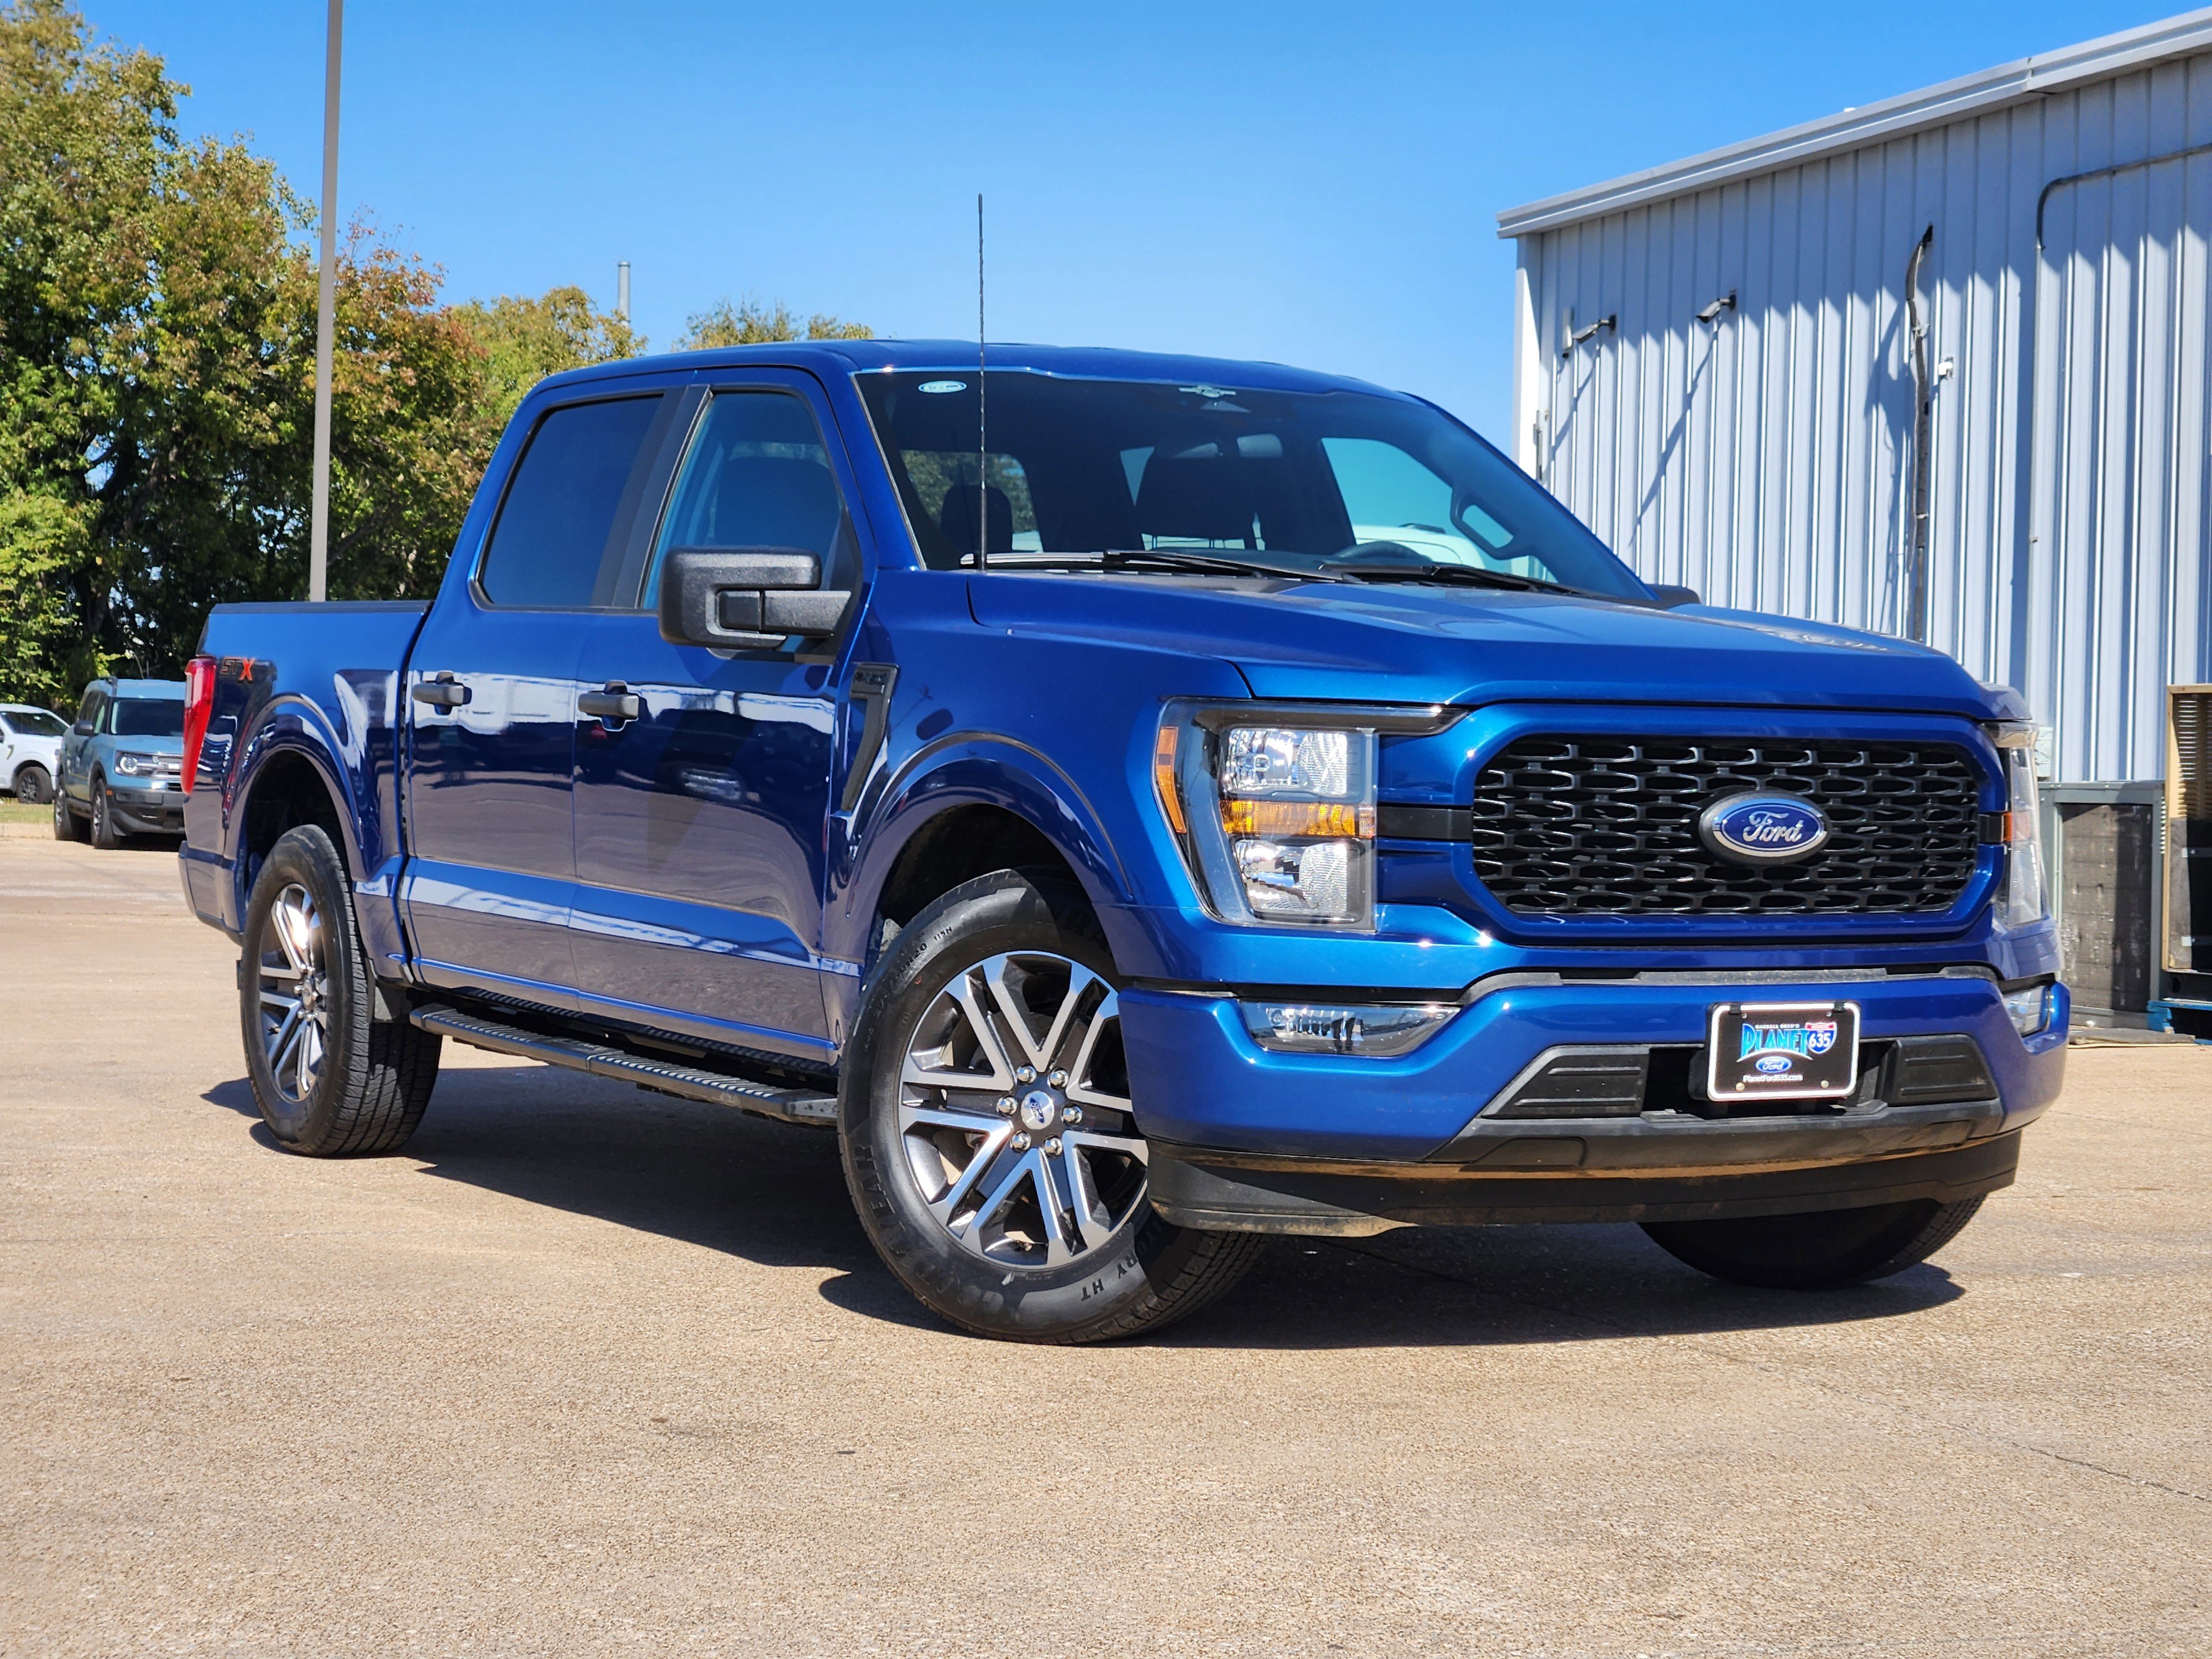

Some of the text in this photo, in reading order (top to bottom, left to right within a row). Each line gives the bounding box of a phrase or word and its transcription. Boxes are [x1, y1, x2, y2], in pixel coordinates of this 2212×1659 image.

[220, 657, 255, 681] STX
[1743, 811, 1804, 842] Ford
[1740, 1023, 1831, 1058] PLANET 635
[1762, 1058, 1784, 1071] Ford
[1030, 1102, 1044, 1119] Ford
[1081, 1278, 1104, 1301] HT
